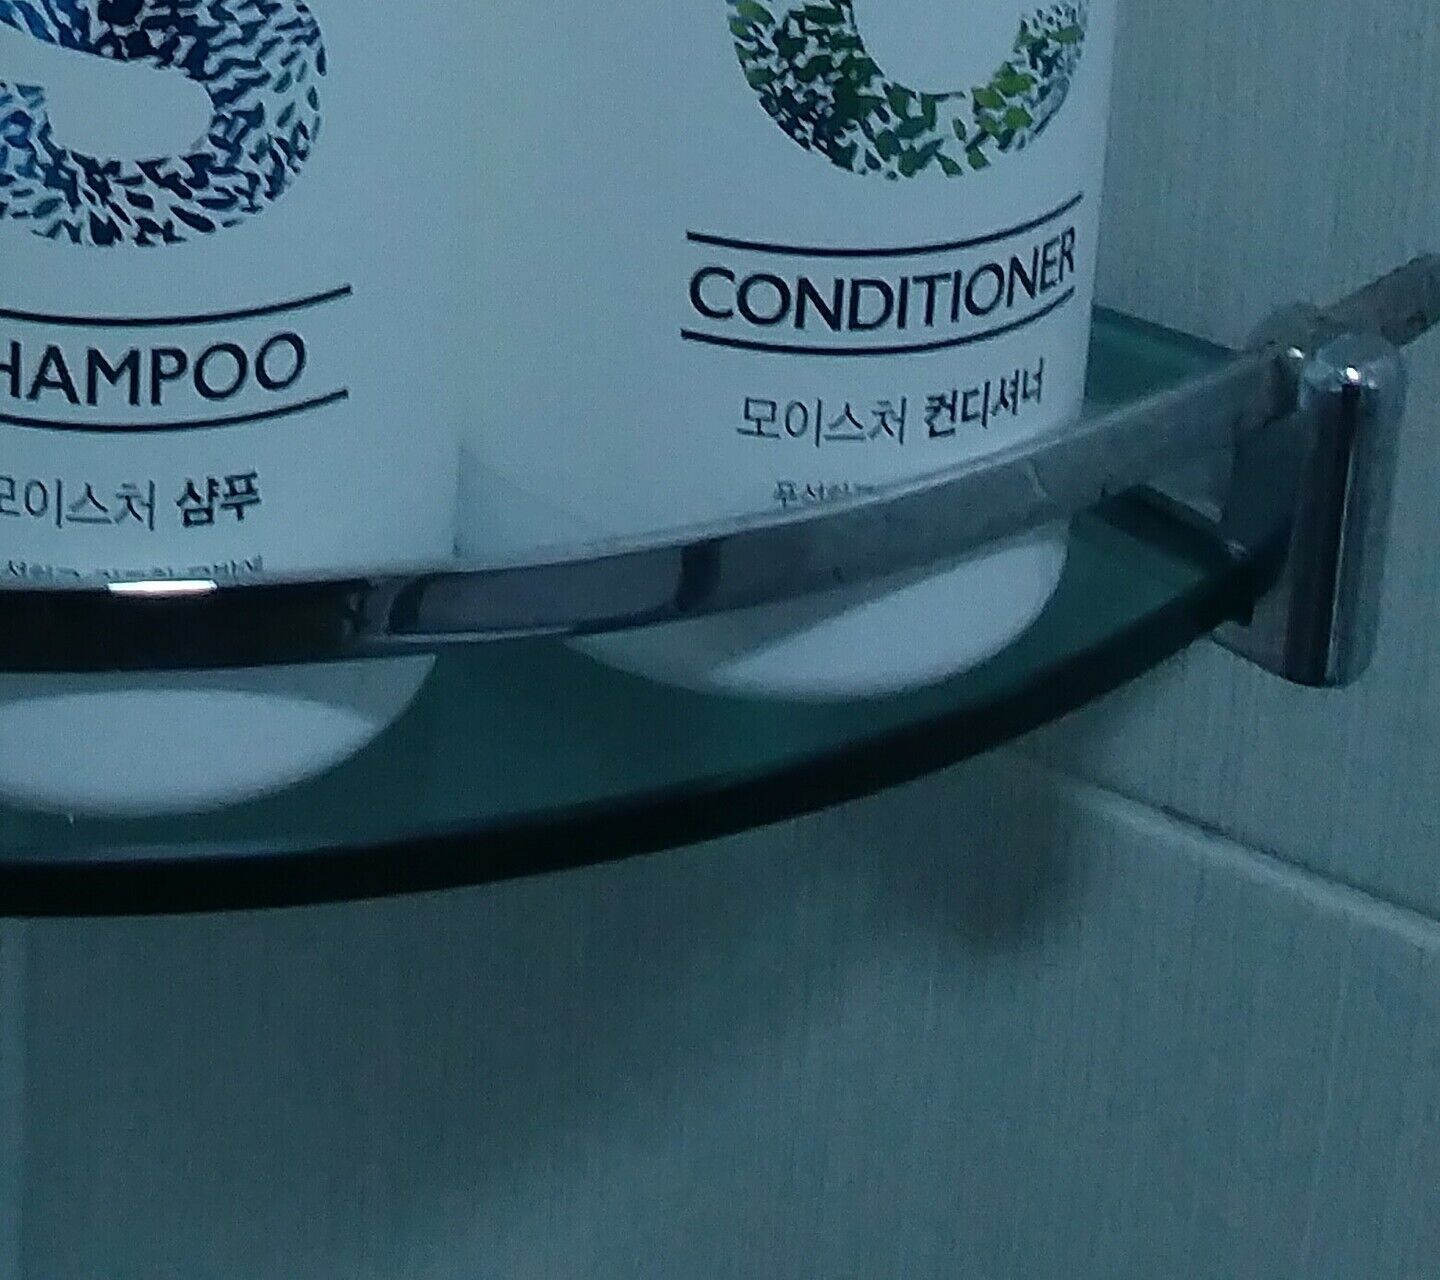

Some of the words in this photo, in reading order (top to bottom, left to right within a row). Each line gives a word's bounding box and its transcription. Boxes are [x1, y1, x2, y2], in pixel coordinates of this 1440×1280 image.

[689, 227, 1076, 332] CONDITIONER
[736, 396, 908, 448] 모이스처
[924, 356, 1046, 439] 컨디셔너
[175, 469, 262, 528] 샴푸
